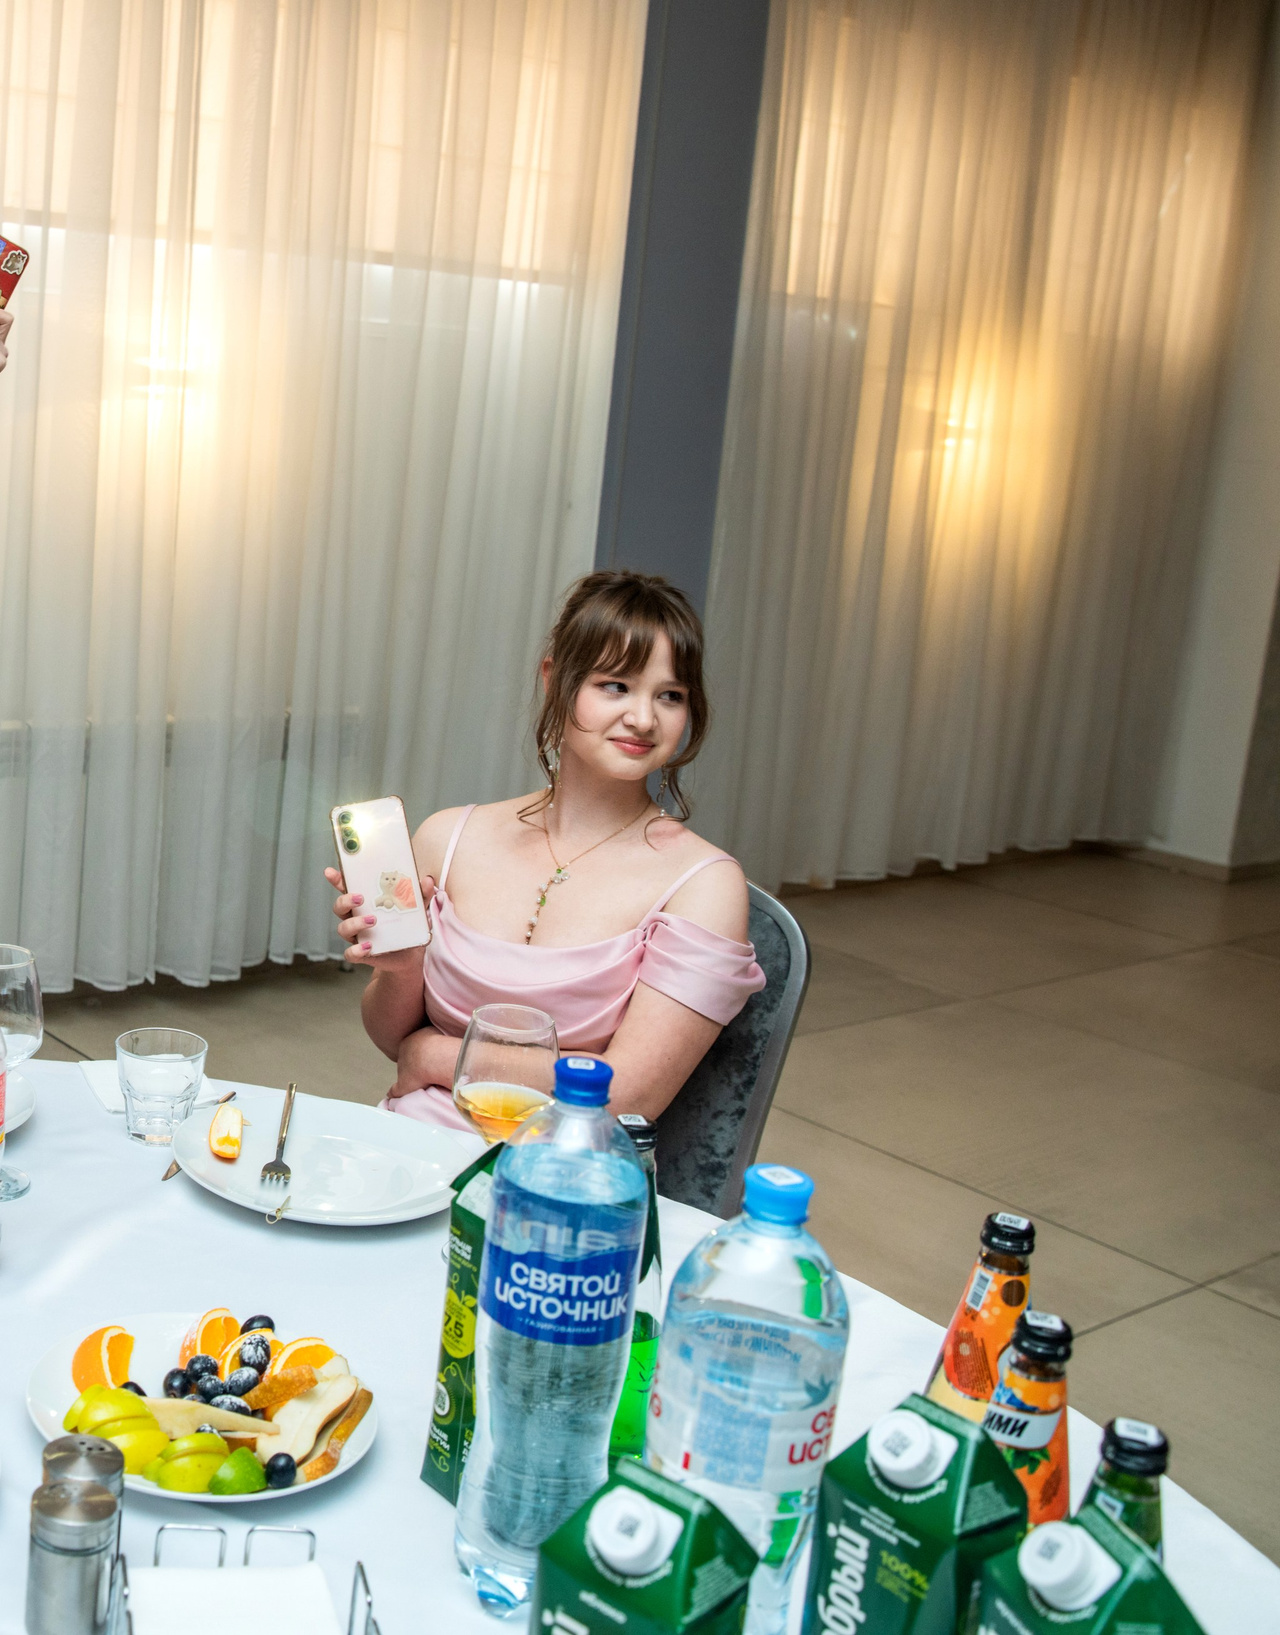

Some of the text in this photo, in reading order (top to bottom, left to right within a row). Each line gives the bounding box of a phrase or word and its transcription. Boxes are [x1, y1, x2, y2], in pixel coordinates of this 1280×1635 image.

[494, 1276, 629, 1322] ИСТОЧНИК
[510, 1262, 621, 1298] СВЯТОЙ
[524, 1318, 597, 1334] ГАЗИРОВАННАЯ
[787, 1433, 832, 1465] ИСТ
[817, 1522, 871, 1635] брый
[879, 1549, 931, 1592] 100%
